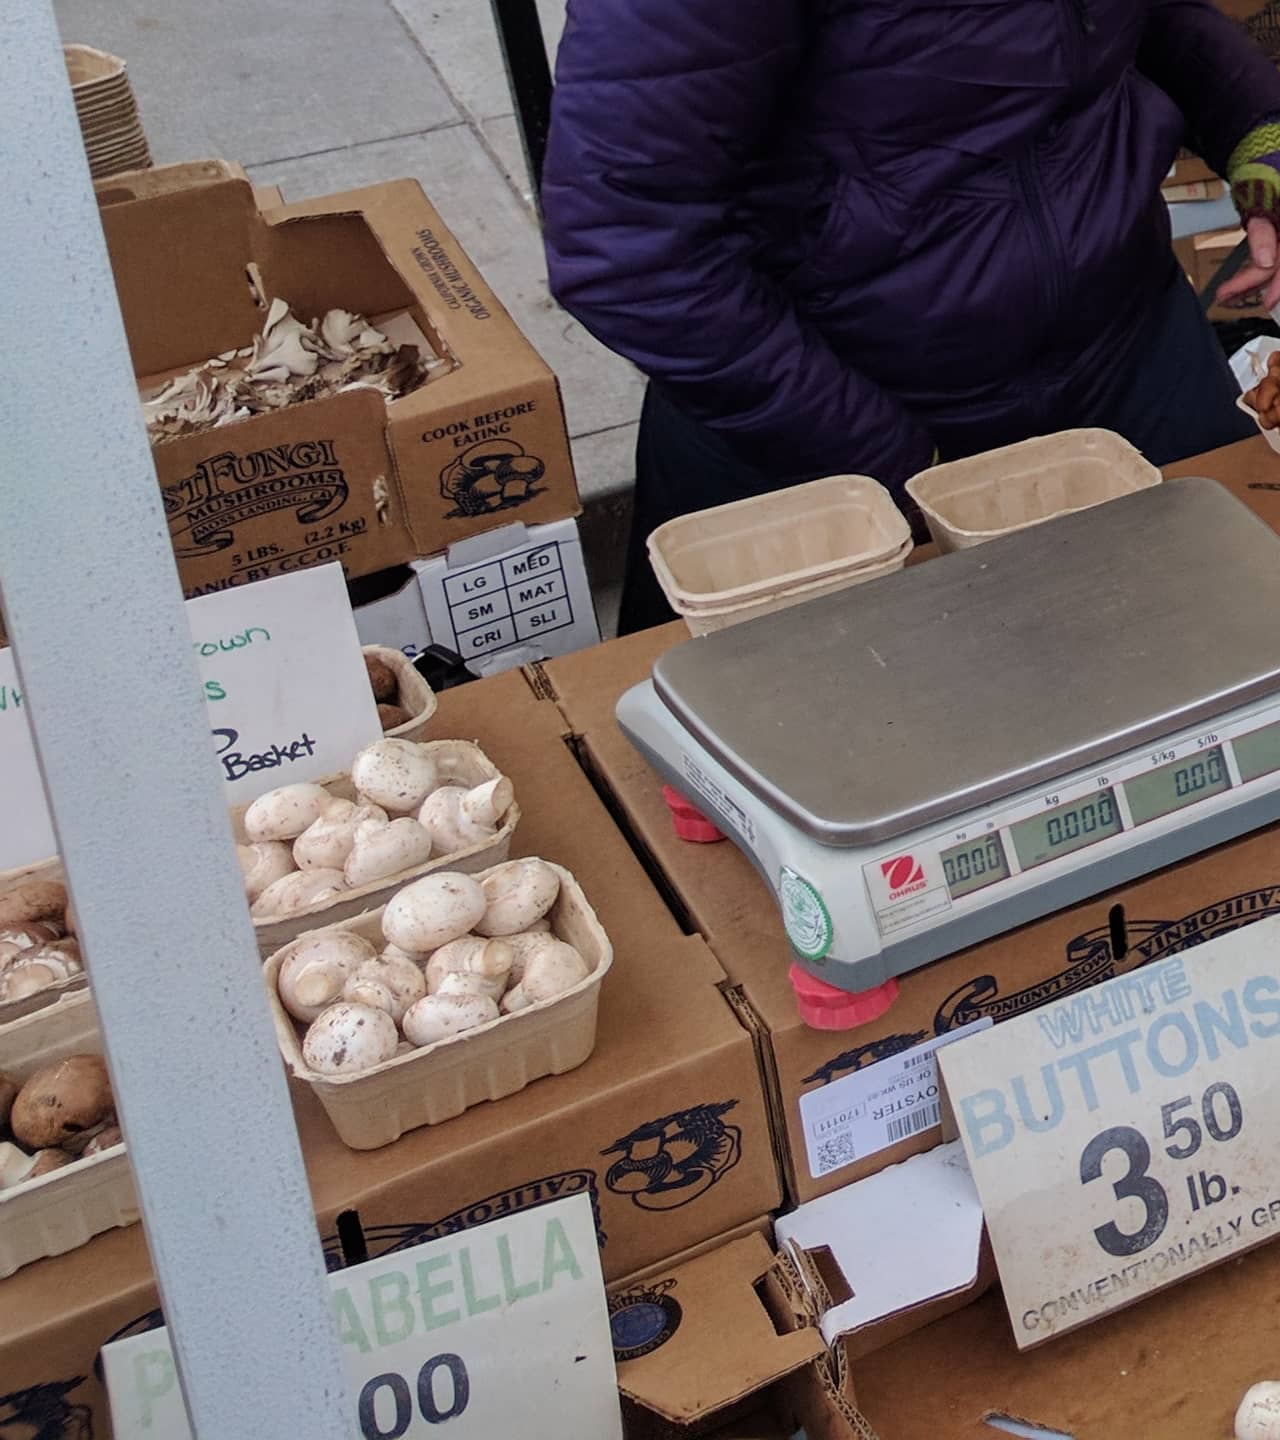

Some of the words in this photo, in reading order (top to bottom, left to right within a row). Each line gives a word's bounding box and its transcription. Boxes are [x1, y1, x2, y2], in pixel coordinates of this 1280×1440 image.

[421, 420, 470, 444] COOK
[473, 400, 536, 428] BEFORE
[453, 422, 511, 448] EATING
[186, 471, 339, 524] MUSHROOMS
[195, 515, 236, 537] MOSS
[232, 555, 242, 566] 5
[247, 543, 285, 561] LBS.
[305, 526, 334, 545] (2.2
[339, 516, 367, 534] Kg)
[247, 563, 274, 582] BY
[463, 577, 487, 593] LG
[513, 554, 550, 576] MED
[468, 603, 493, 620] SM
[519, 581, 554, 602] MAT
[473, 630, 501, 647] CRI
[530, 611, 556, 627] SLI
[223, 733, 316, 781] Basket
[1151, 748, 1176, 766] $/kg
[1197, 732, 1218, 748] $/lb
[1045, 794, 1060, 806] kg
[1097, 776, 1109, 787] lb
[1175, 758, 1223, 798] 0.00
[1047, 796, 1115, 848] 0.000
[888, 880, 927, 902] OHAUS
[1038, 957, 1191, 1049] WHITE
[873, 1084, 938, 1121] OYSTER
[1186, 1170, 1240, 1211] lb.
[1021, 1216, 1242, 1332] CONVENTIONALLY
